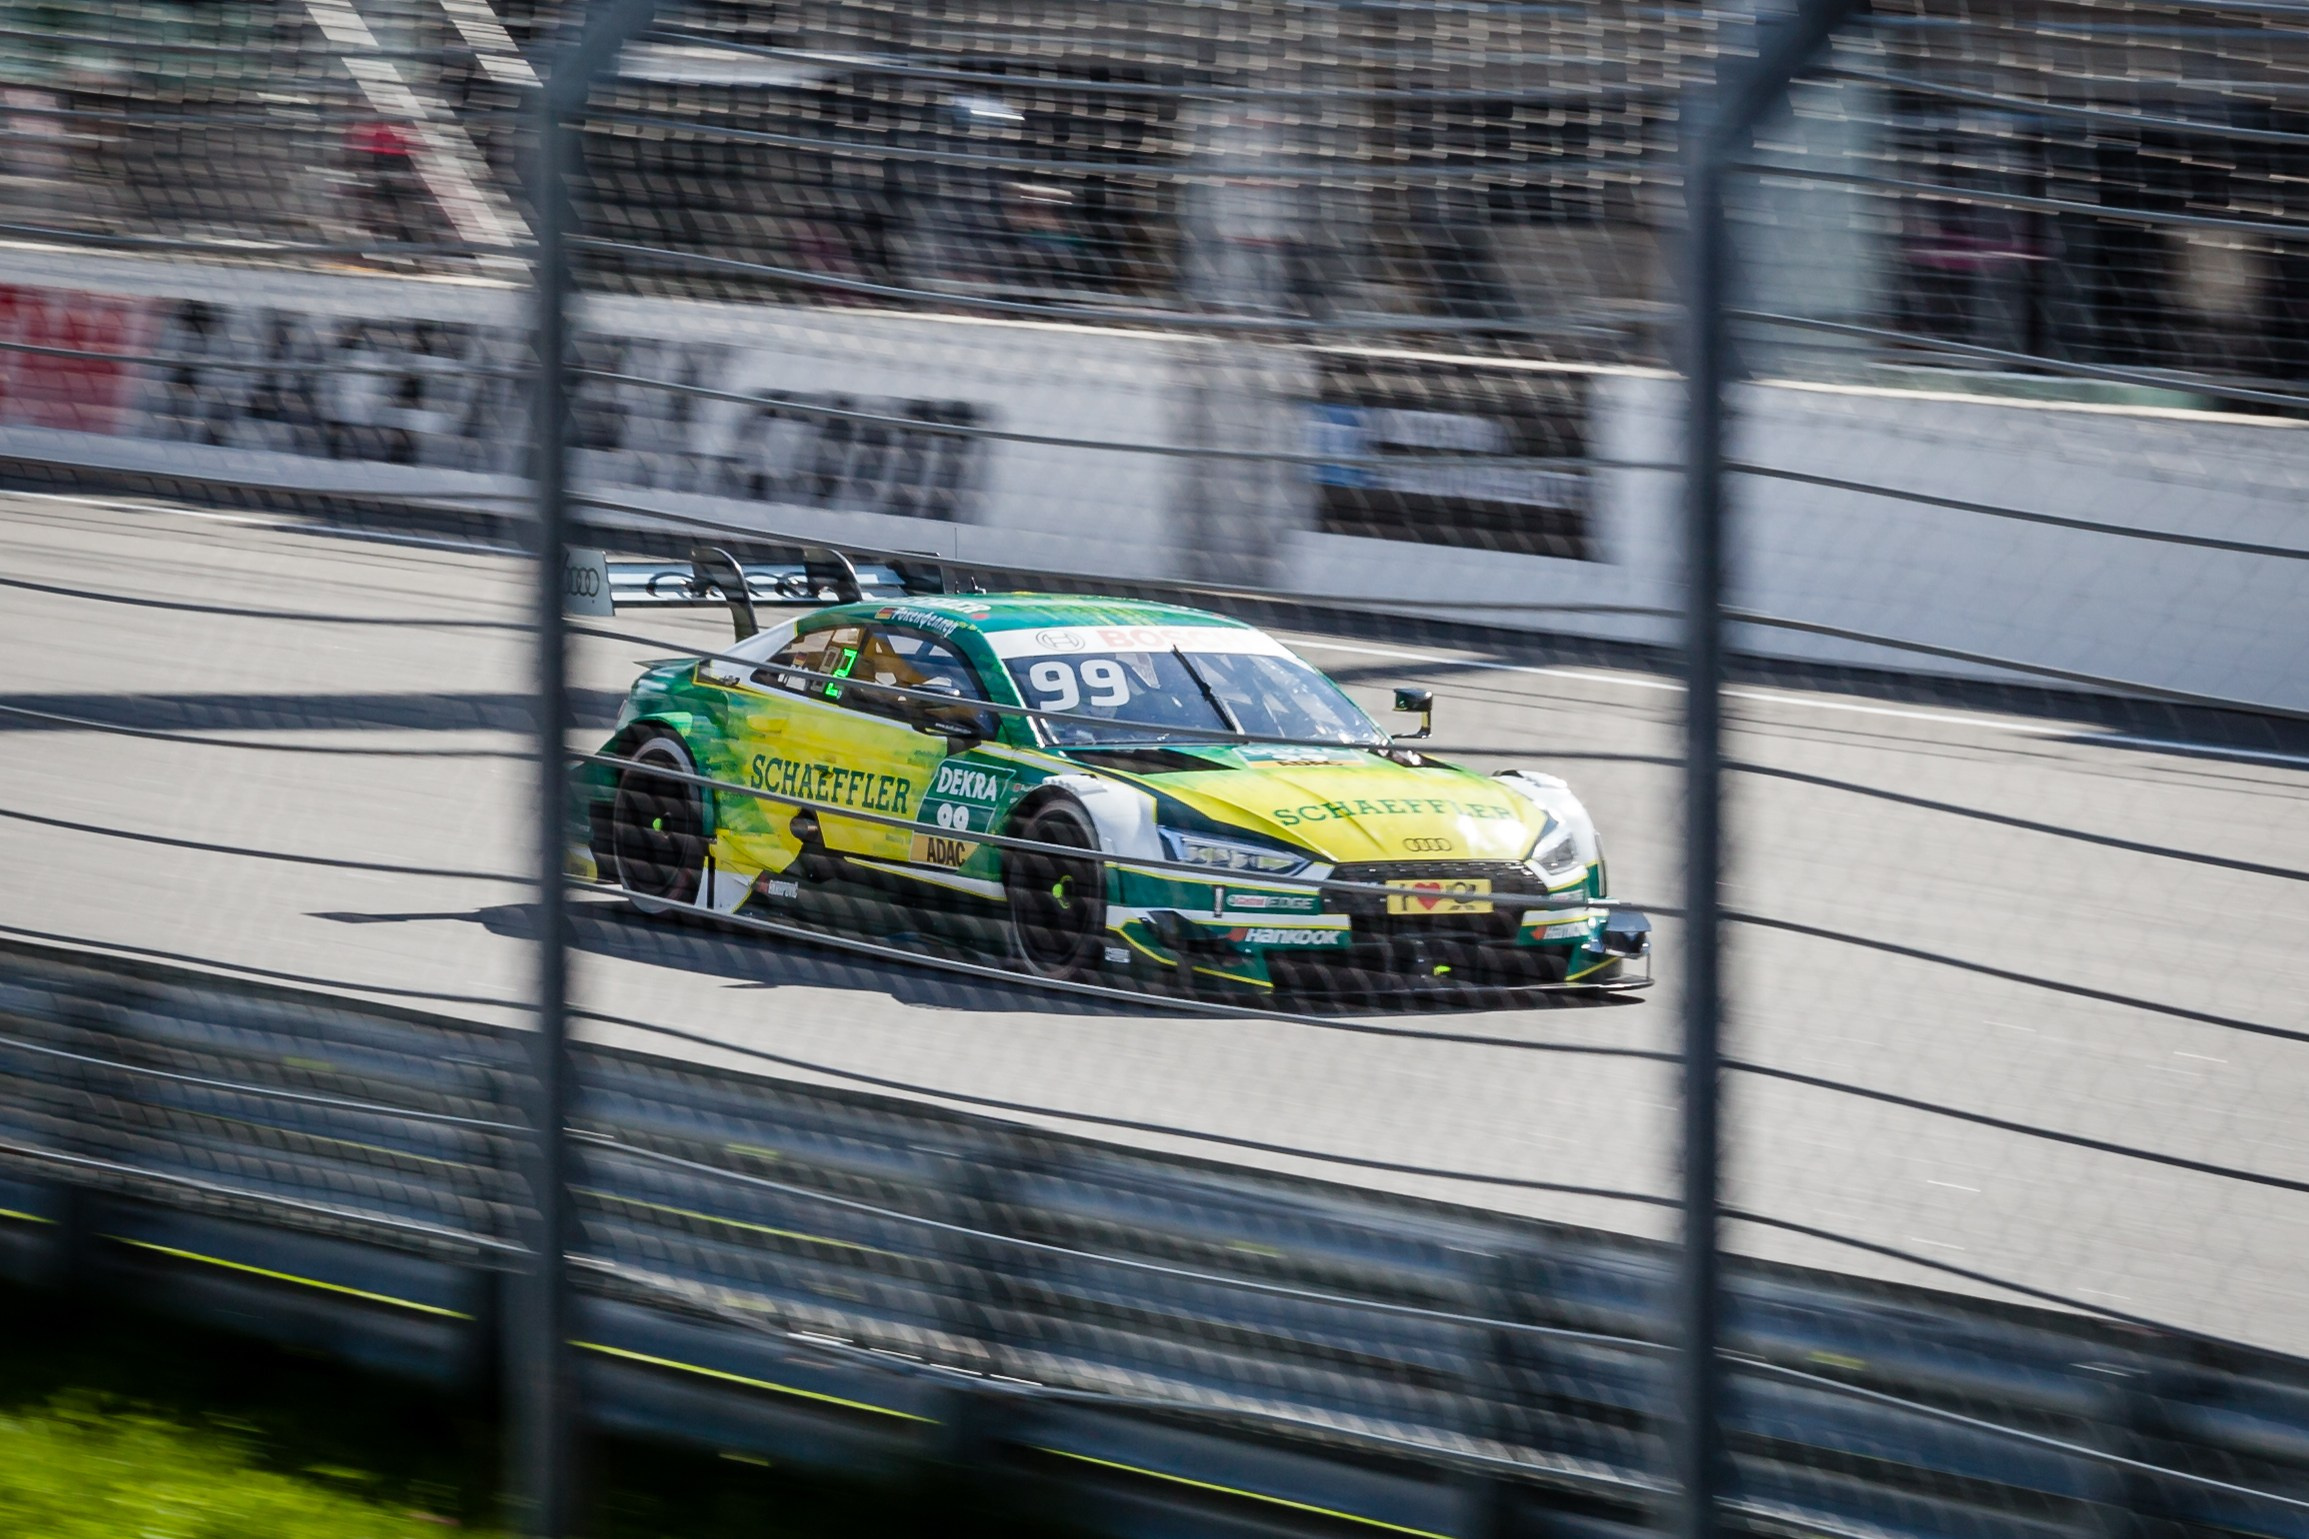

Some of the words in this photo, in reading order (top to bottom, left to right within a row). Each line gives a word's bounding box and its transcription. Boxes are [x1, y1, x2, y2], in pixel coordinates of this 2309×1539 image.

[1096, 629, 1248, 649] BOSC
[1029, 659, 1131, 712] 99
[751, 753, 911, 815] SCHAEFFLER
[936, 766, 998, 802] DEKRA
[1273, 799, 1517, 826] SCHAEFFLER
[926, 836, 966, 866] ADAC
